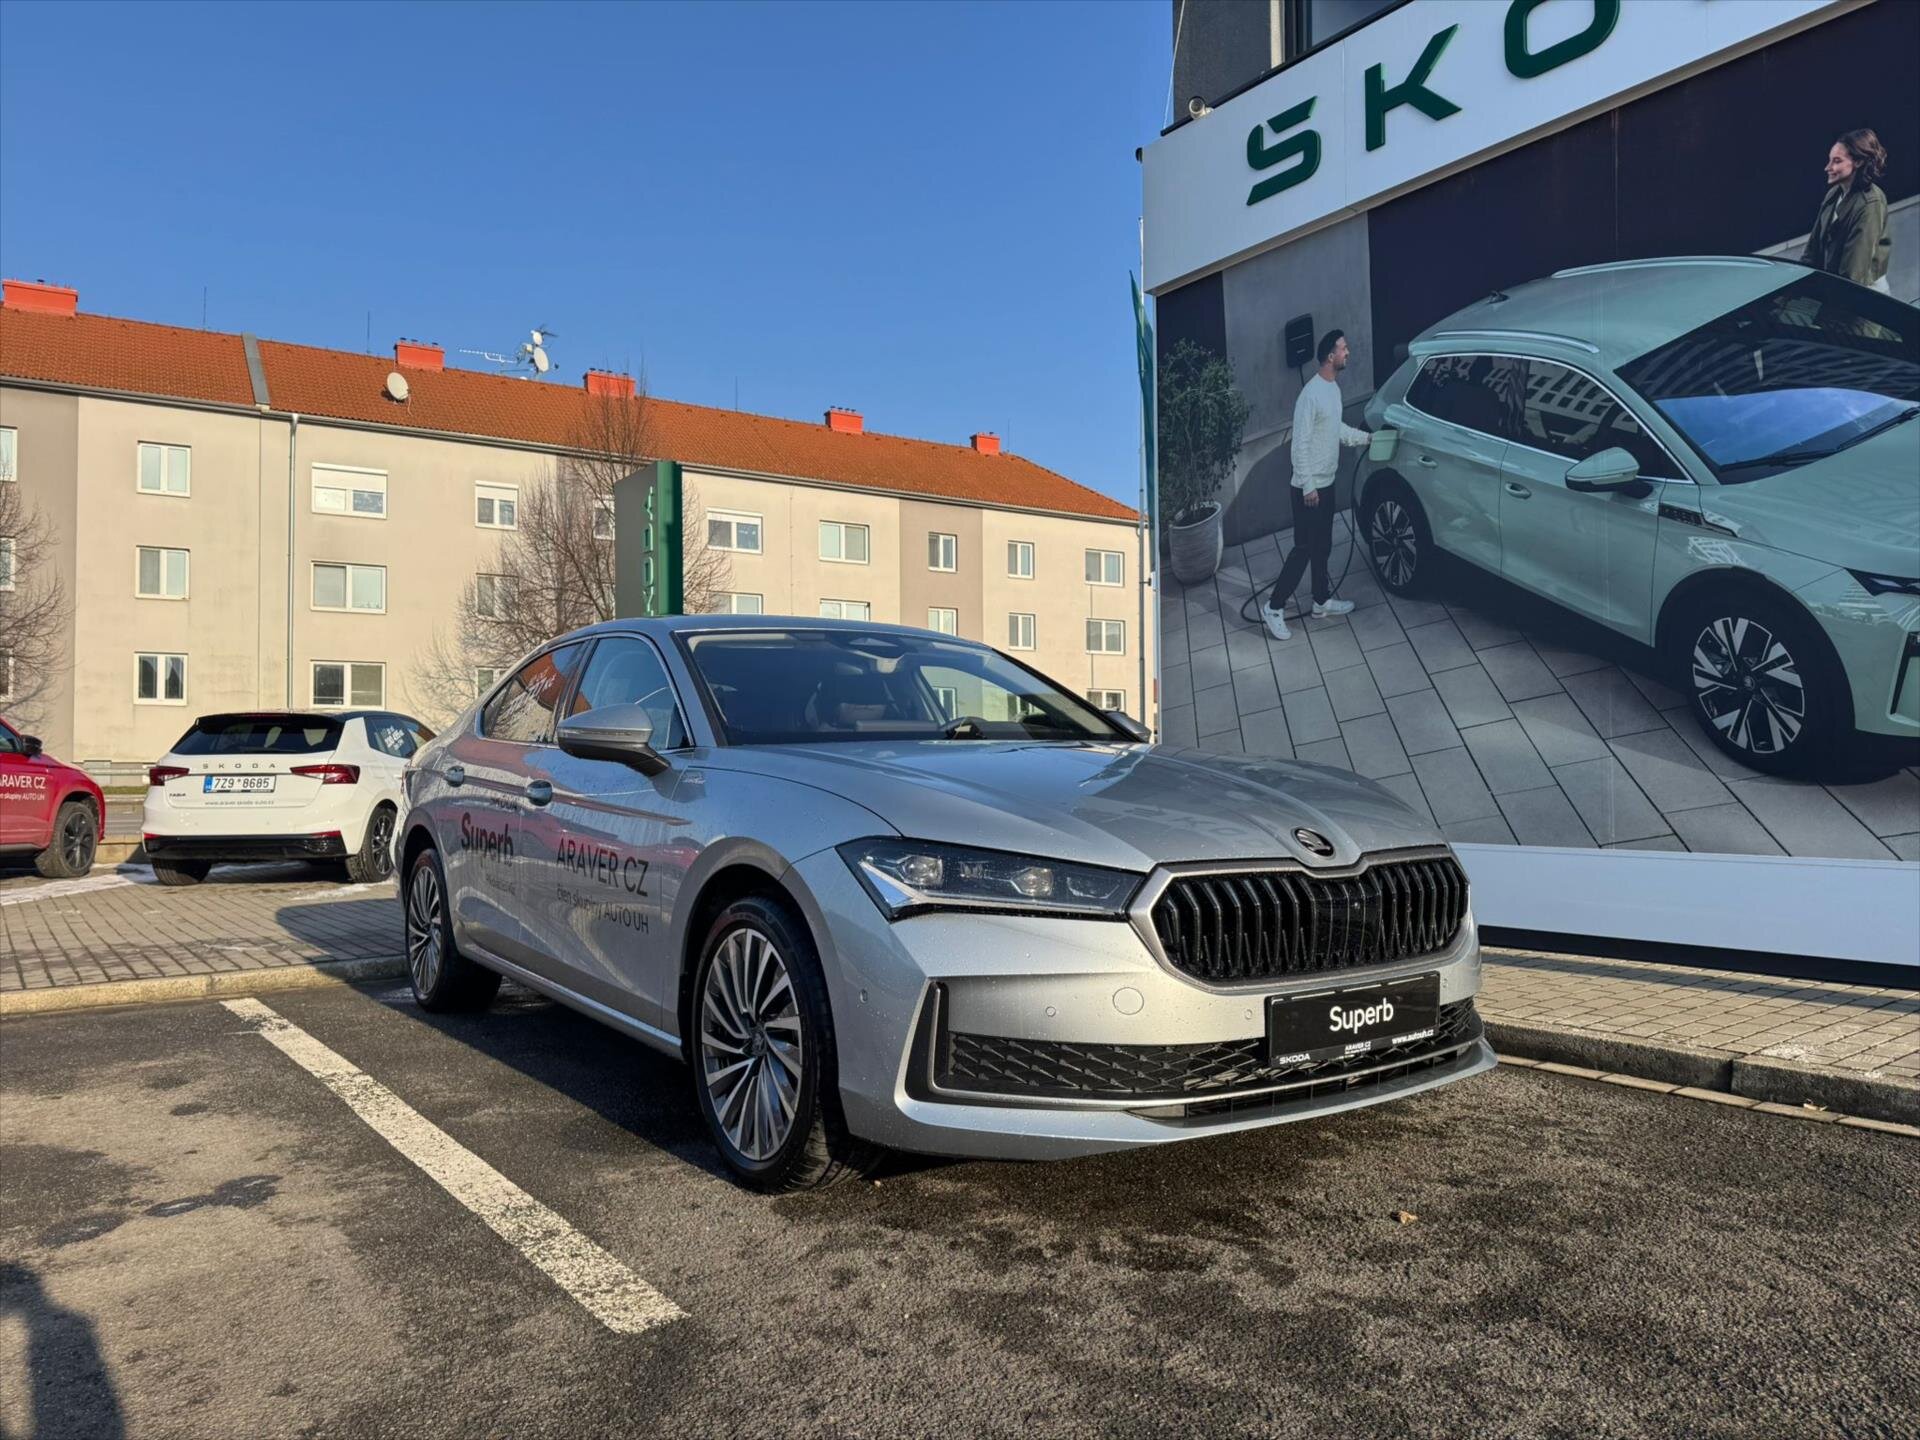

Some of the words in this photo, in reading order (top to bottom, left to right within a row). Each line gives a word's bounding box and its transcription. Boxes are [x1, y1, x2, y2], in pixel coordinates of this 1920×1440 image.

[1247, 0, 1622, 206] SKO
[642, 486, 654, 617] KODA
[34, 776, 46, 789] CZ
[243, 778, 270, 788] 8685
[461, 812, 514, 868] Superb
[556, 838, 619, 888] ARAVER
[623, 855, 649, 897] CZ
[604, 902, 631, 928] AUTO
[633, 911, 649, 934] UH
[1329, 998, 1394, 1034] Superb
